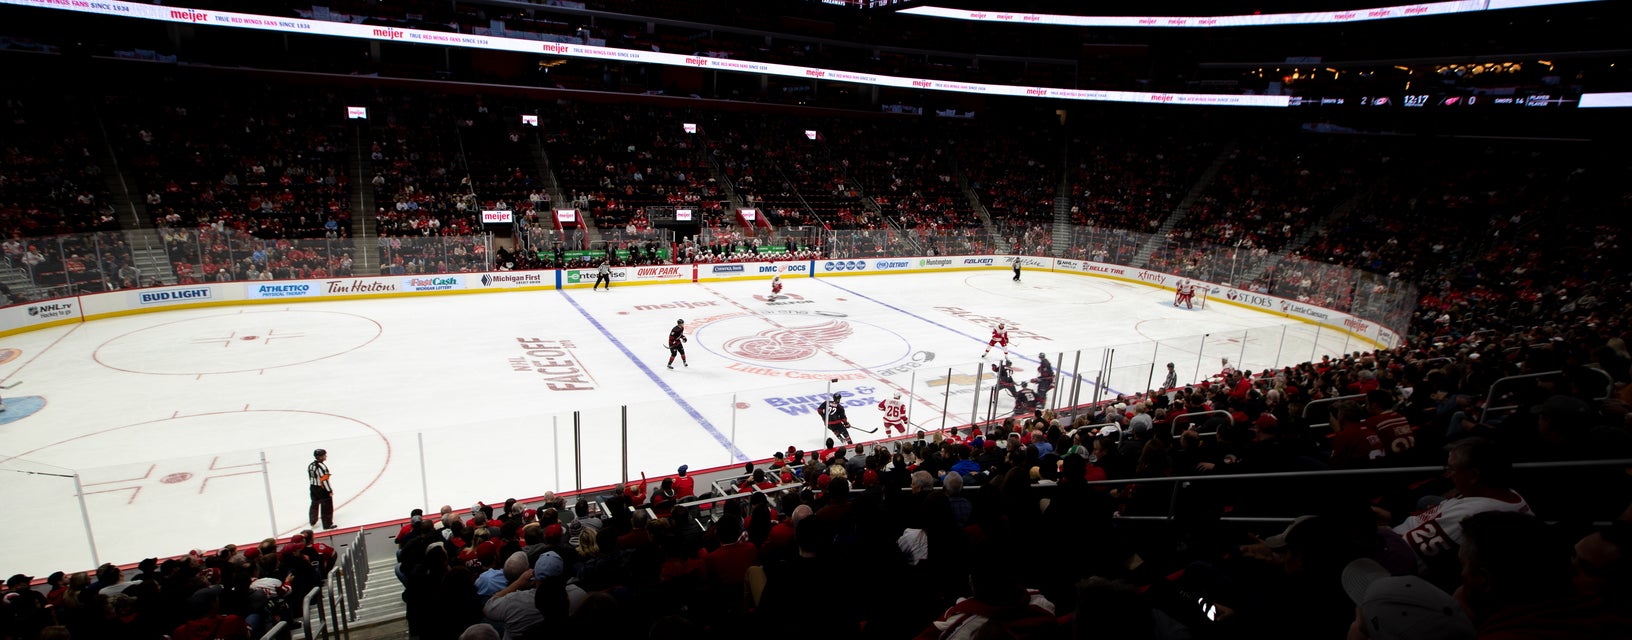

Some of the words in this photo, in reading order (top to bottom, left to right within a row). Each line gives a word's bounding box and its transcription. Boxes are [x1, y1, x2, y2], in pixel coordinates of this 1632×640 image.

[170, 8, 208, 22] meijer
[373, 27, 404, 40] meijer
[543, 43, 568, 54] meijer
[686, 56, 708, 66] meijer
[806, 68, 825, 78] meijer
[912, 80, 932, 88] meijer
[1026, 87, 1047, 96] meijer
[1150, 93, 1174, 102] meijer
[1360, 96, 1368, 105] 2
[1404, 95, 1430, 104] 12:17
[1468, 96, 1476, 106] 0
[484, 212, 510, 222] meijer
[926, 258, 952, 266] Huntington
[637, 268, 658, 276] QWIK
[658, 266, 680, 275] PARK
[1089, 264, 1108, 273] BELLE
[1138, 270, 1166, 285] xfinity
[258, 284, 310, 292] ATHLETICO
[326, 280, 349, 293] Tim
[350, 280, 396, 292] Hortons
[142, 292, 170, 302] BUD
[172, 289, 208, 300] LIGHT
[632, 300, 721, 310] meijer
[1290, 304, 1306, 312] Little
[1307, 308, 1328, 319] Caesars
[1344, 317, 1369, 332] meijer
[725, 362, 781, 378] Little
[854, 386, 876, 395] &
[887, 406, 900, 418] 26
[1410, 523, 1452, 558] 25
